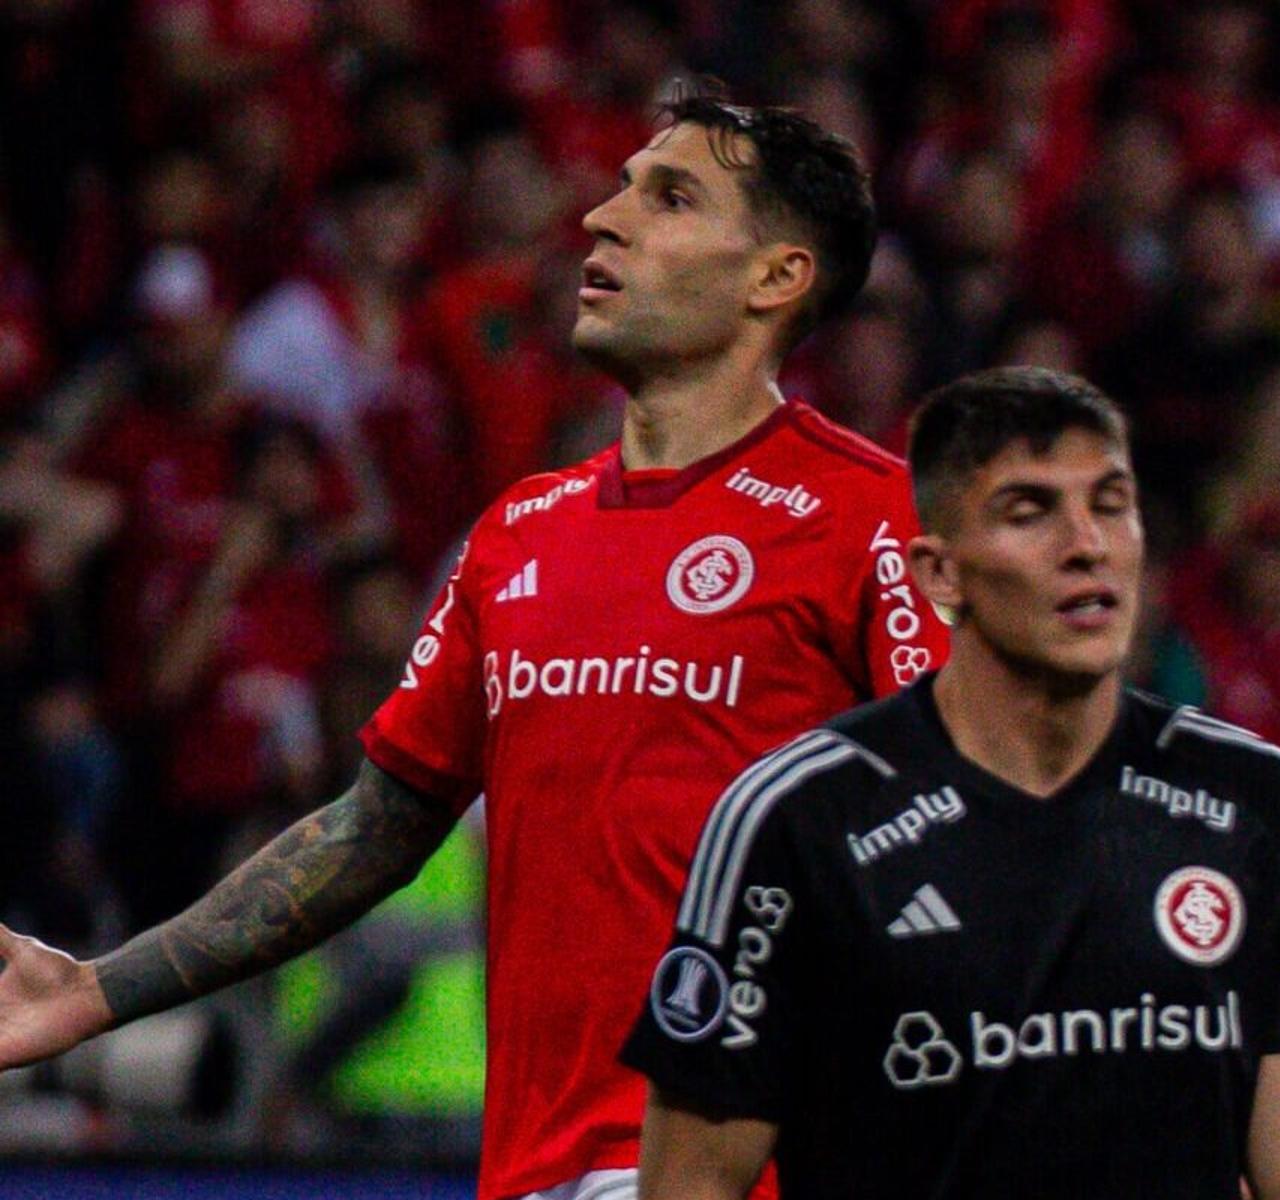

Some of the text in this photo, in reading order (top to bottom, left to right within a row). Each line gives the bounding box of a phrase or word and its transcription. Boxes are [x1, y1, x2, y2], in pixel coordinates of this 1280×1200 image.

[726, 466, 822, 518] imply
[868, 520, 922, 641] vero
[508, 644, 744, 706] banrisul
[847, 784, 968, 867] imply
[1119, 765, 1238, 833] imply
[719, 926, 774, 1049] vero
[970, 990, 1242, 1068] banrisul
